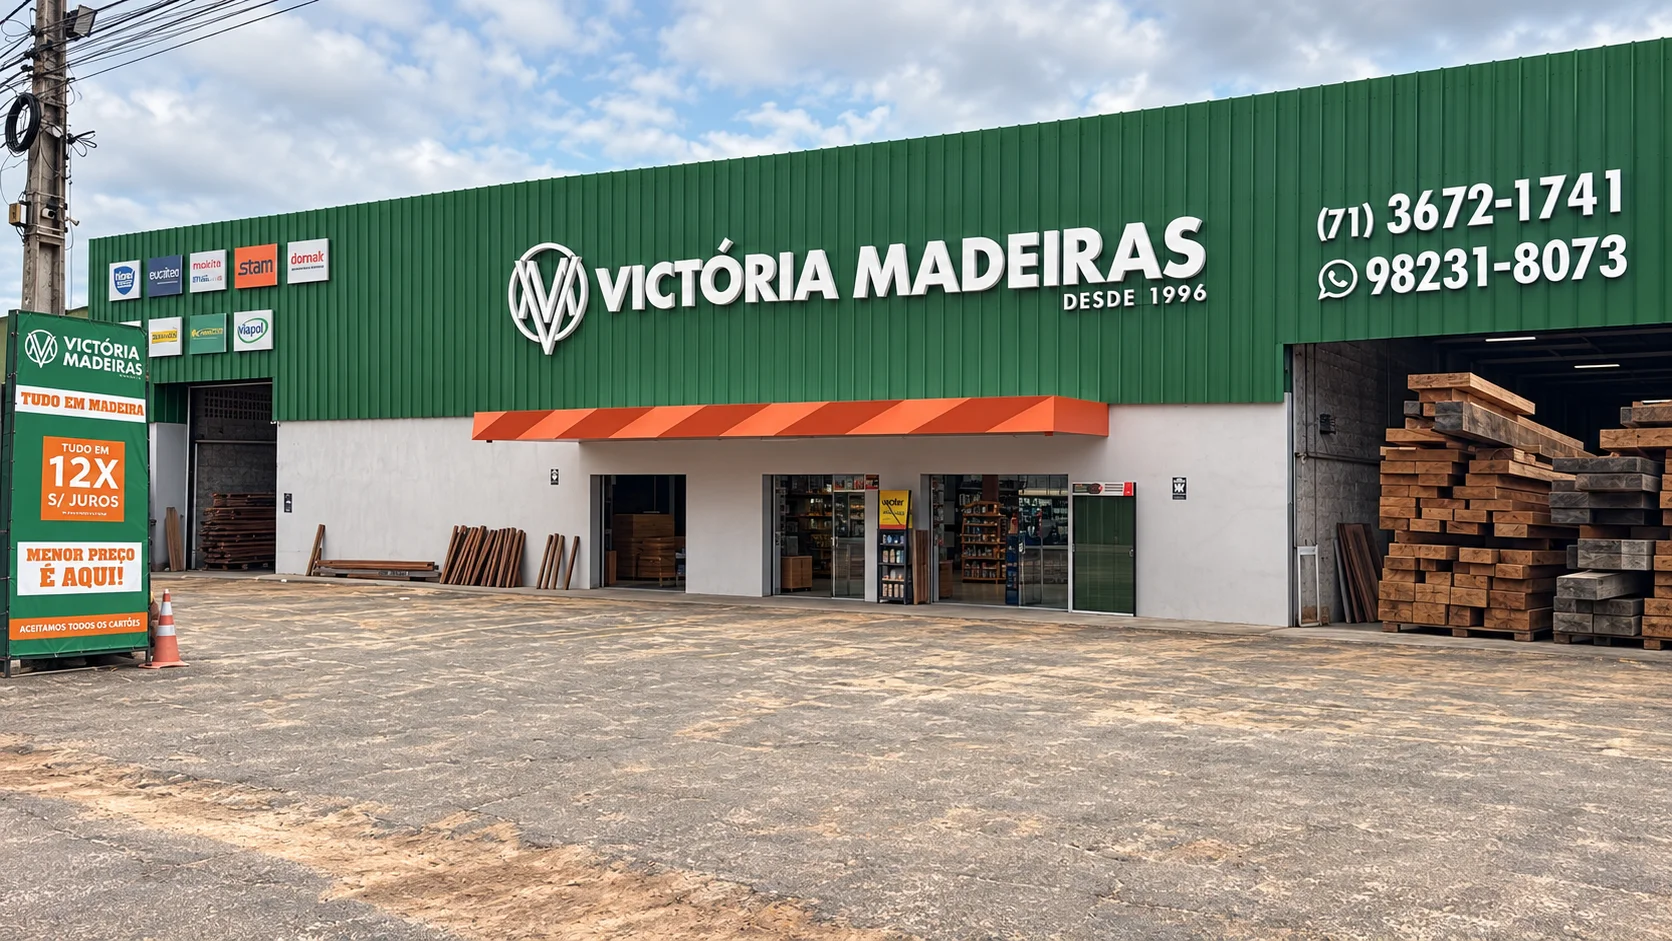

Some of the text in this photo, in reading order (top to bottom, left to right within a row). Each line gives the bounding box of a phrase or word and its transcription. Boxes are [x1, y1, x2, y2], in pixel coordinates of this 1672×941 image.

[1317, 168, 1622, 242] (71) 3672-1741
[238, 259, 273, 276] stam
[594, 216, 1207, 313] VICTÓRIA MADEIRAS
[1365, 233, 1628, 296] 98231-8073
[1063, 284, 1207, 311] DESDE 1996
[237, 322, 264, 337] viapol
[63, 337, 140, 361] VICTÓRIA
[63, 352, 143, 376] MADEIRAS
[20, 391, 145, 417] TUDO EM MADEIRA
[61, 443, 110, 455] TUDO EM
[49, 455, 120, 490] 12X
[47, 492, 120, 508] S/ JUROS
[26, 547, 136, 565] MENOR PREÇO
[39, 562, 124, 589] É AQUI!
[19, 623, 67, 634] ACEITAMOS
[68, 621, 96, 631] TODOS
[96, 621, 108, 629] OS
